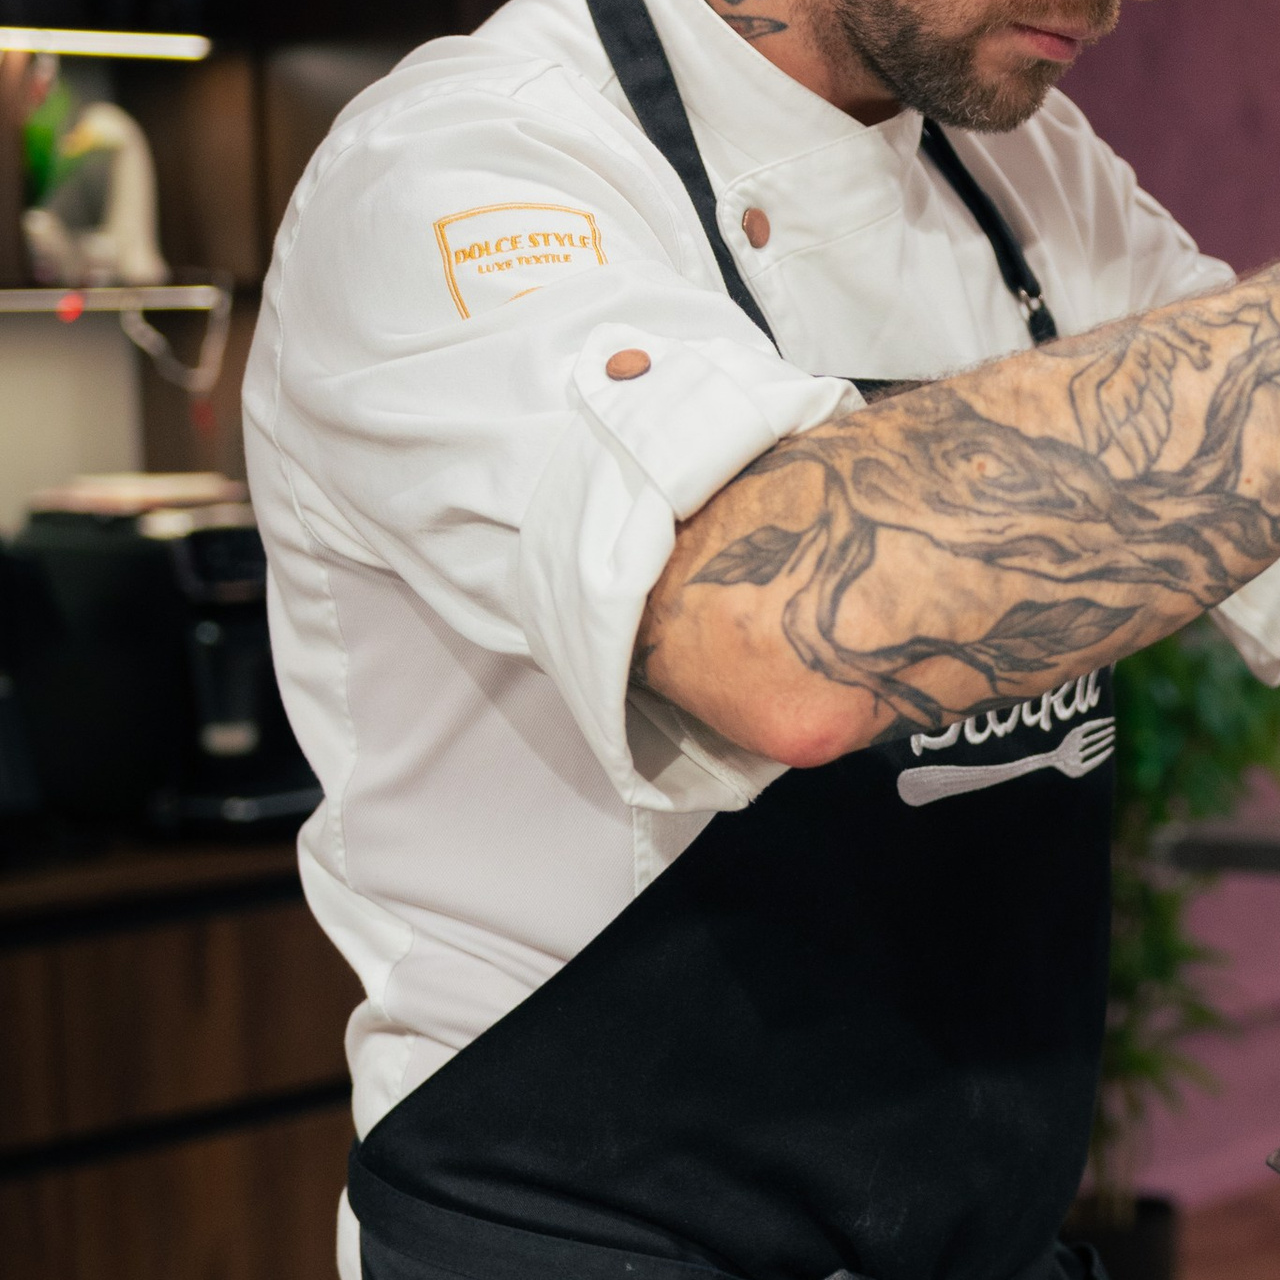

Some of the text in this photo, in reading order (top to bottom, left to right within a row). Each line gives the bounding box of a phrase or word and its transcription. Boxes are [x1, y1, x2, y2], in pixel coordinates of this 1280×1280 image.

[454, 232, 592, 265] DOLCE STYLE
[477, 253, 572, 275] LUXE TEXTILE
